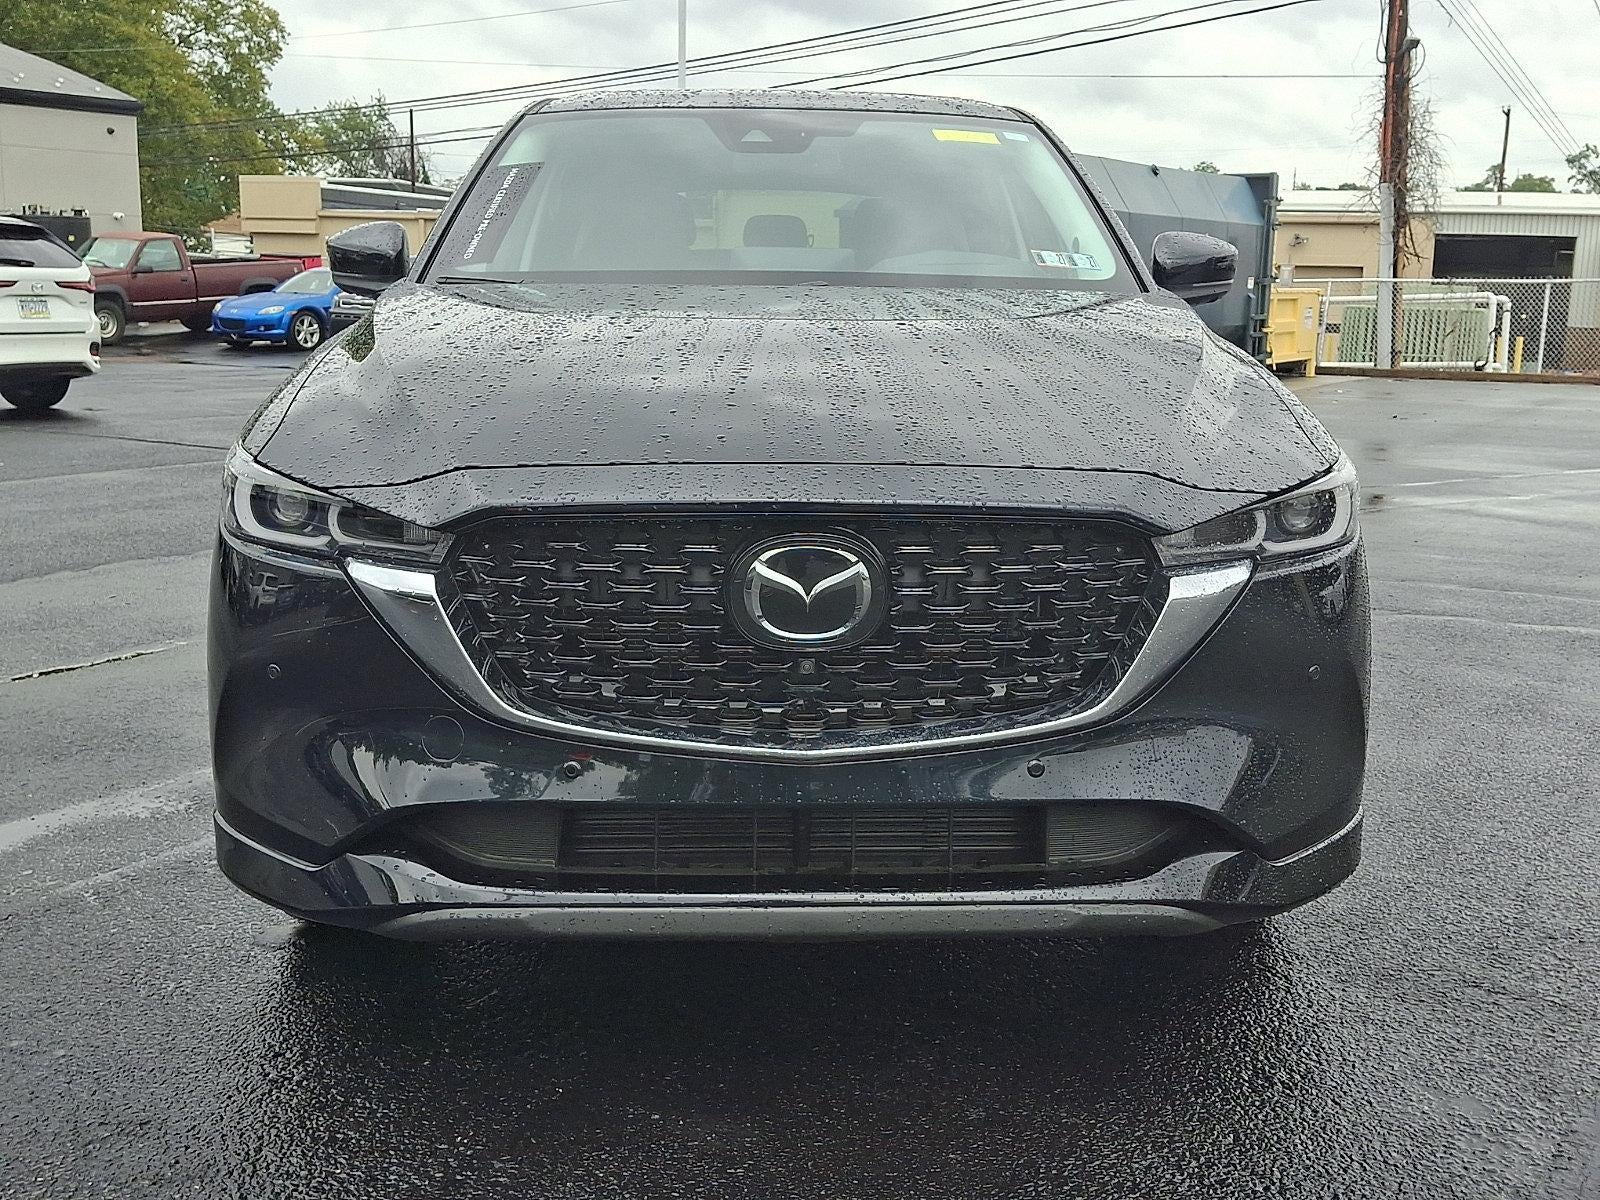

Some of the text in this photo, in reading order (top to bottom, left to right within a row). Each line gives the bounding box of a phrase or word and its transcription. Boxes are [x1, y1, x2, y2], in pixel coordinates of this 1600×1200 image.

[463, 167, 519, 260] MAZDA CERTIFIED PRE-OWNED
